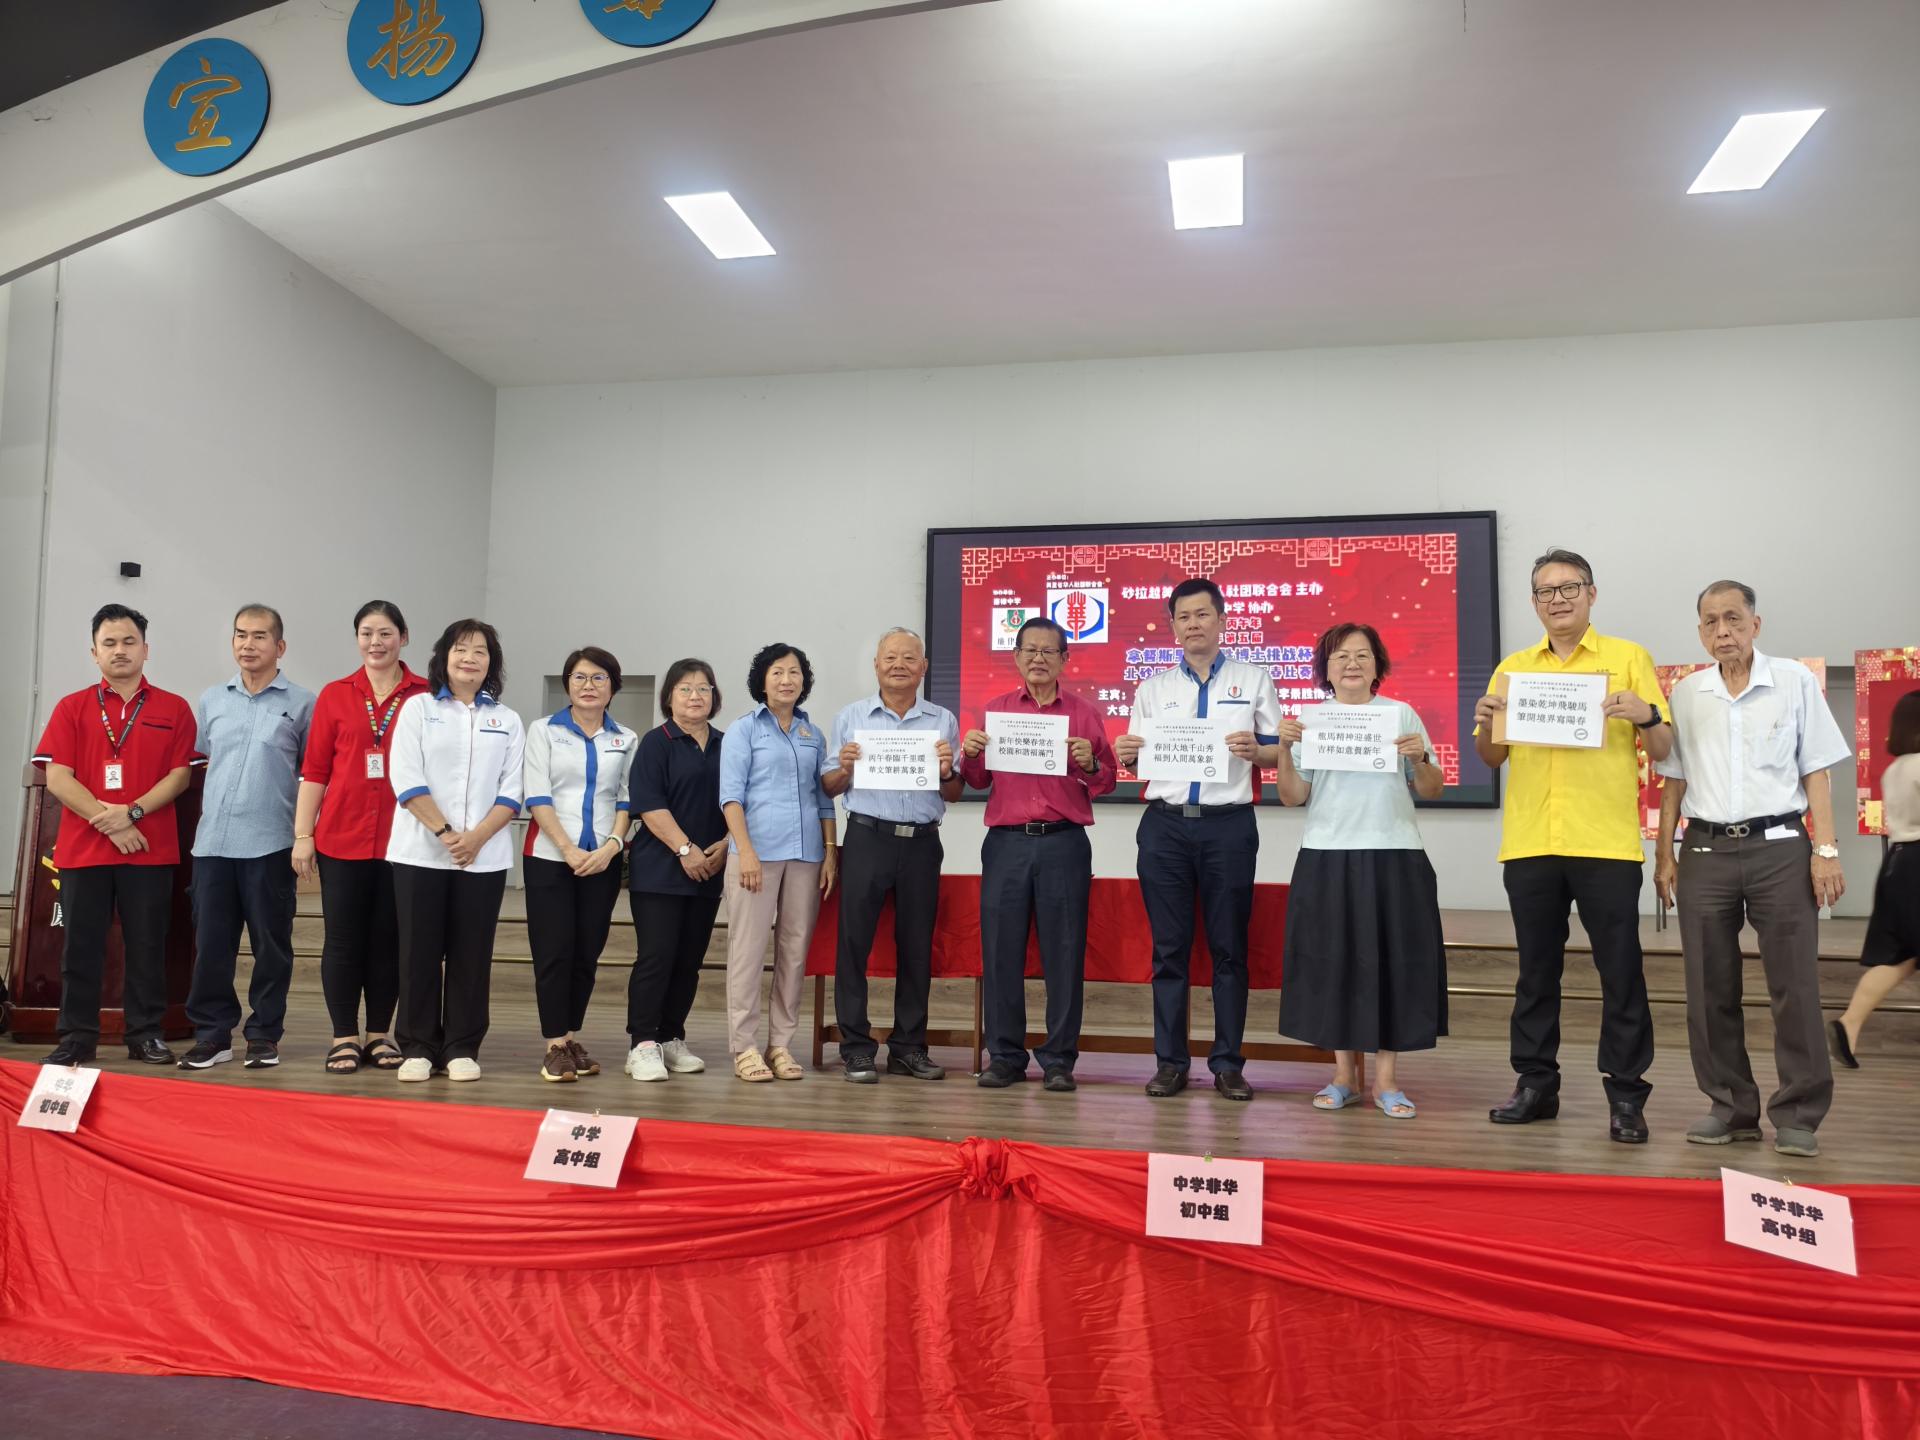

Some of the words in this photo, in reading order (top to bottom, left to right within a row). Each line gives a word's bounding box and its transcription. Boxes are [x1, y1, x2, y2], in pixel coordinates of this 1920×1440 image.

[168, 56, 242, 152] 宣
[1295, 581, 1324, 597] 主办
[1248, 601, 1275, 614] 协办
[1225, 617, 1262, 631] 丙午年
[1106, 704, 1134, 717] 大会
[1153, 742, 1215, 753] 春回大地千山秀
[39, 1098, 71, 1116] 初中组
[571, 1124, 602, 1142] 中学
[553, 1148, 602, 1169] 高中组
[1173, 1175, 1239, 1196] 中学非华
[1180, 1201, 1230, 1221] 初中组
[1750, 1192, 1825, 1222] 中学非华
[1760, 1217, 1818, 1247] 高中组
